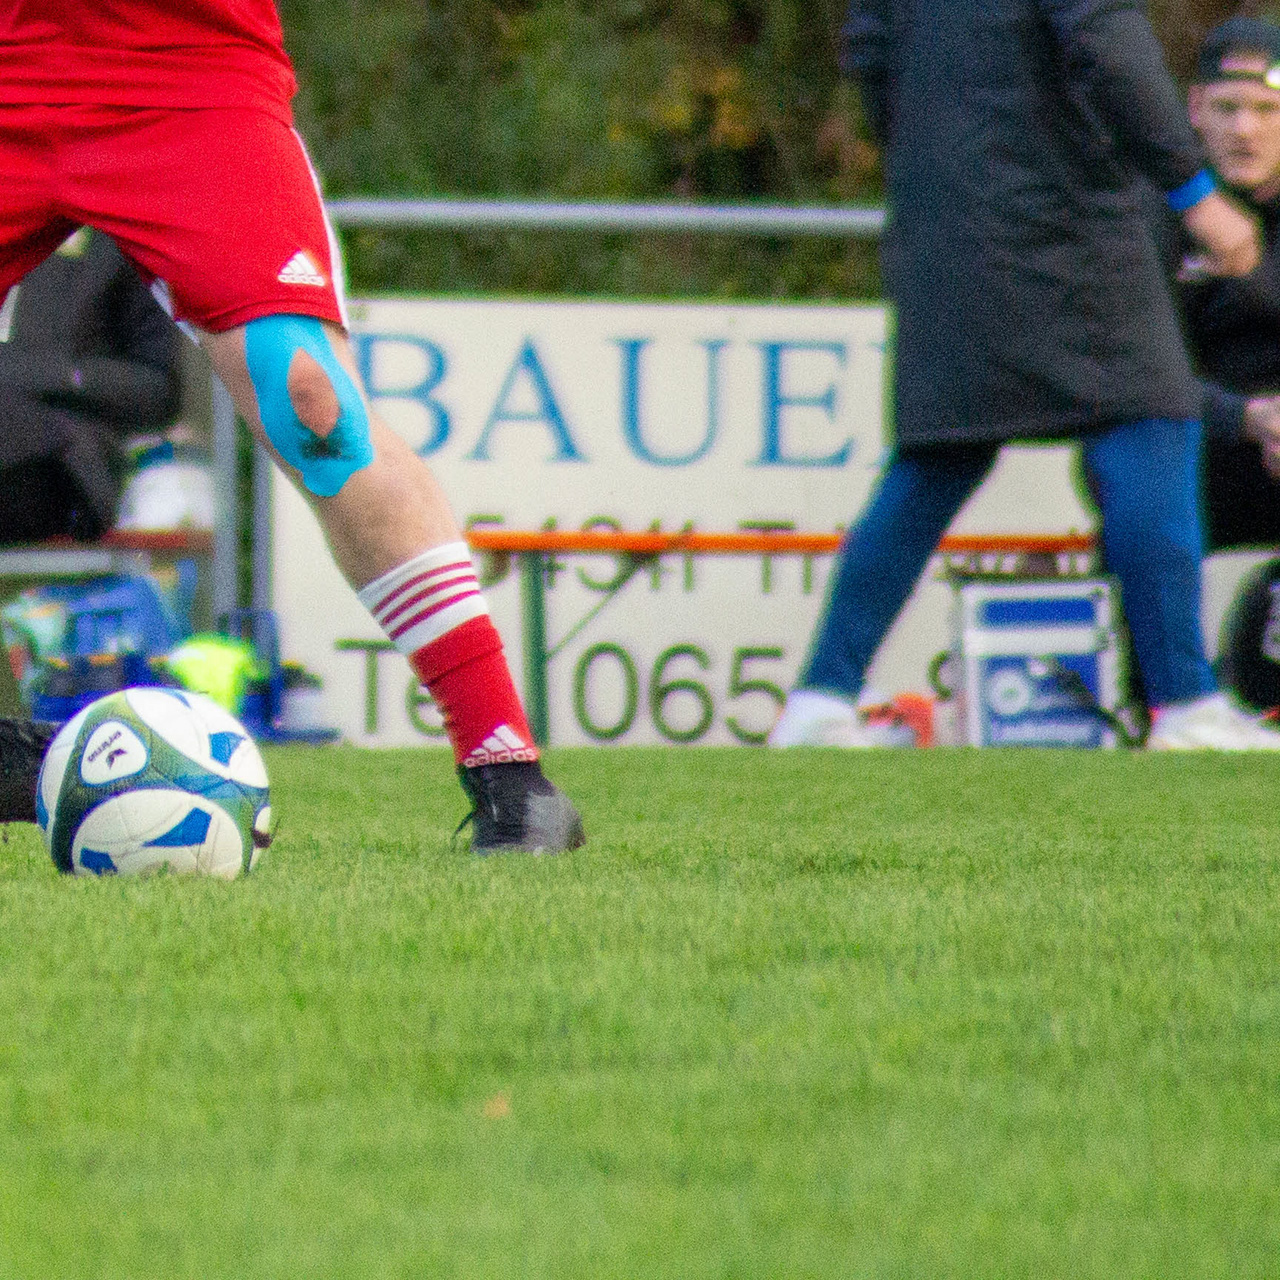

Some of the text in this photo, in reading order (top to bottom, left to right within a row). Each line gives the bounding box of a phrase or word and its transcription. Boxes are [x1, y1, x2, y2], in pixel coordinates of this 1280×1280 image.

[278, 274, 325, 287] adidas
[346, 332, 890, 468] BAUE
[571, 641, 788, 745] 065
[464, 747, 538, 769] adidas
